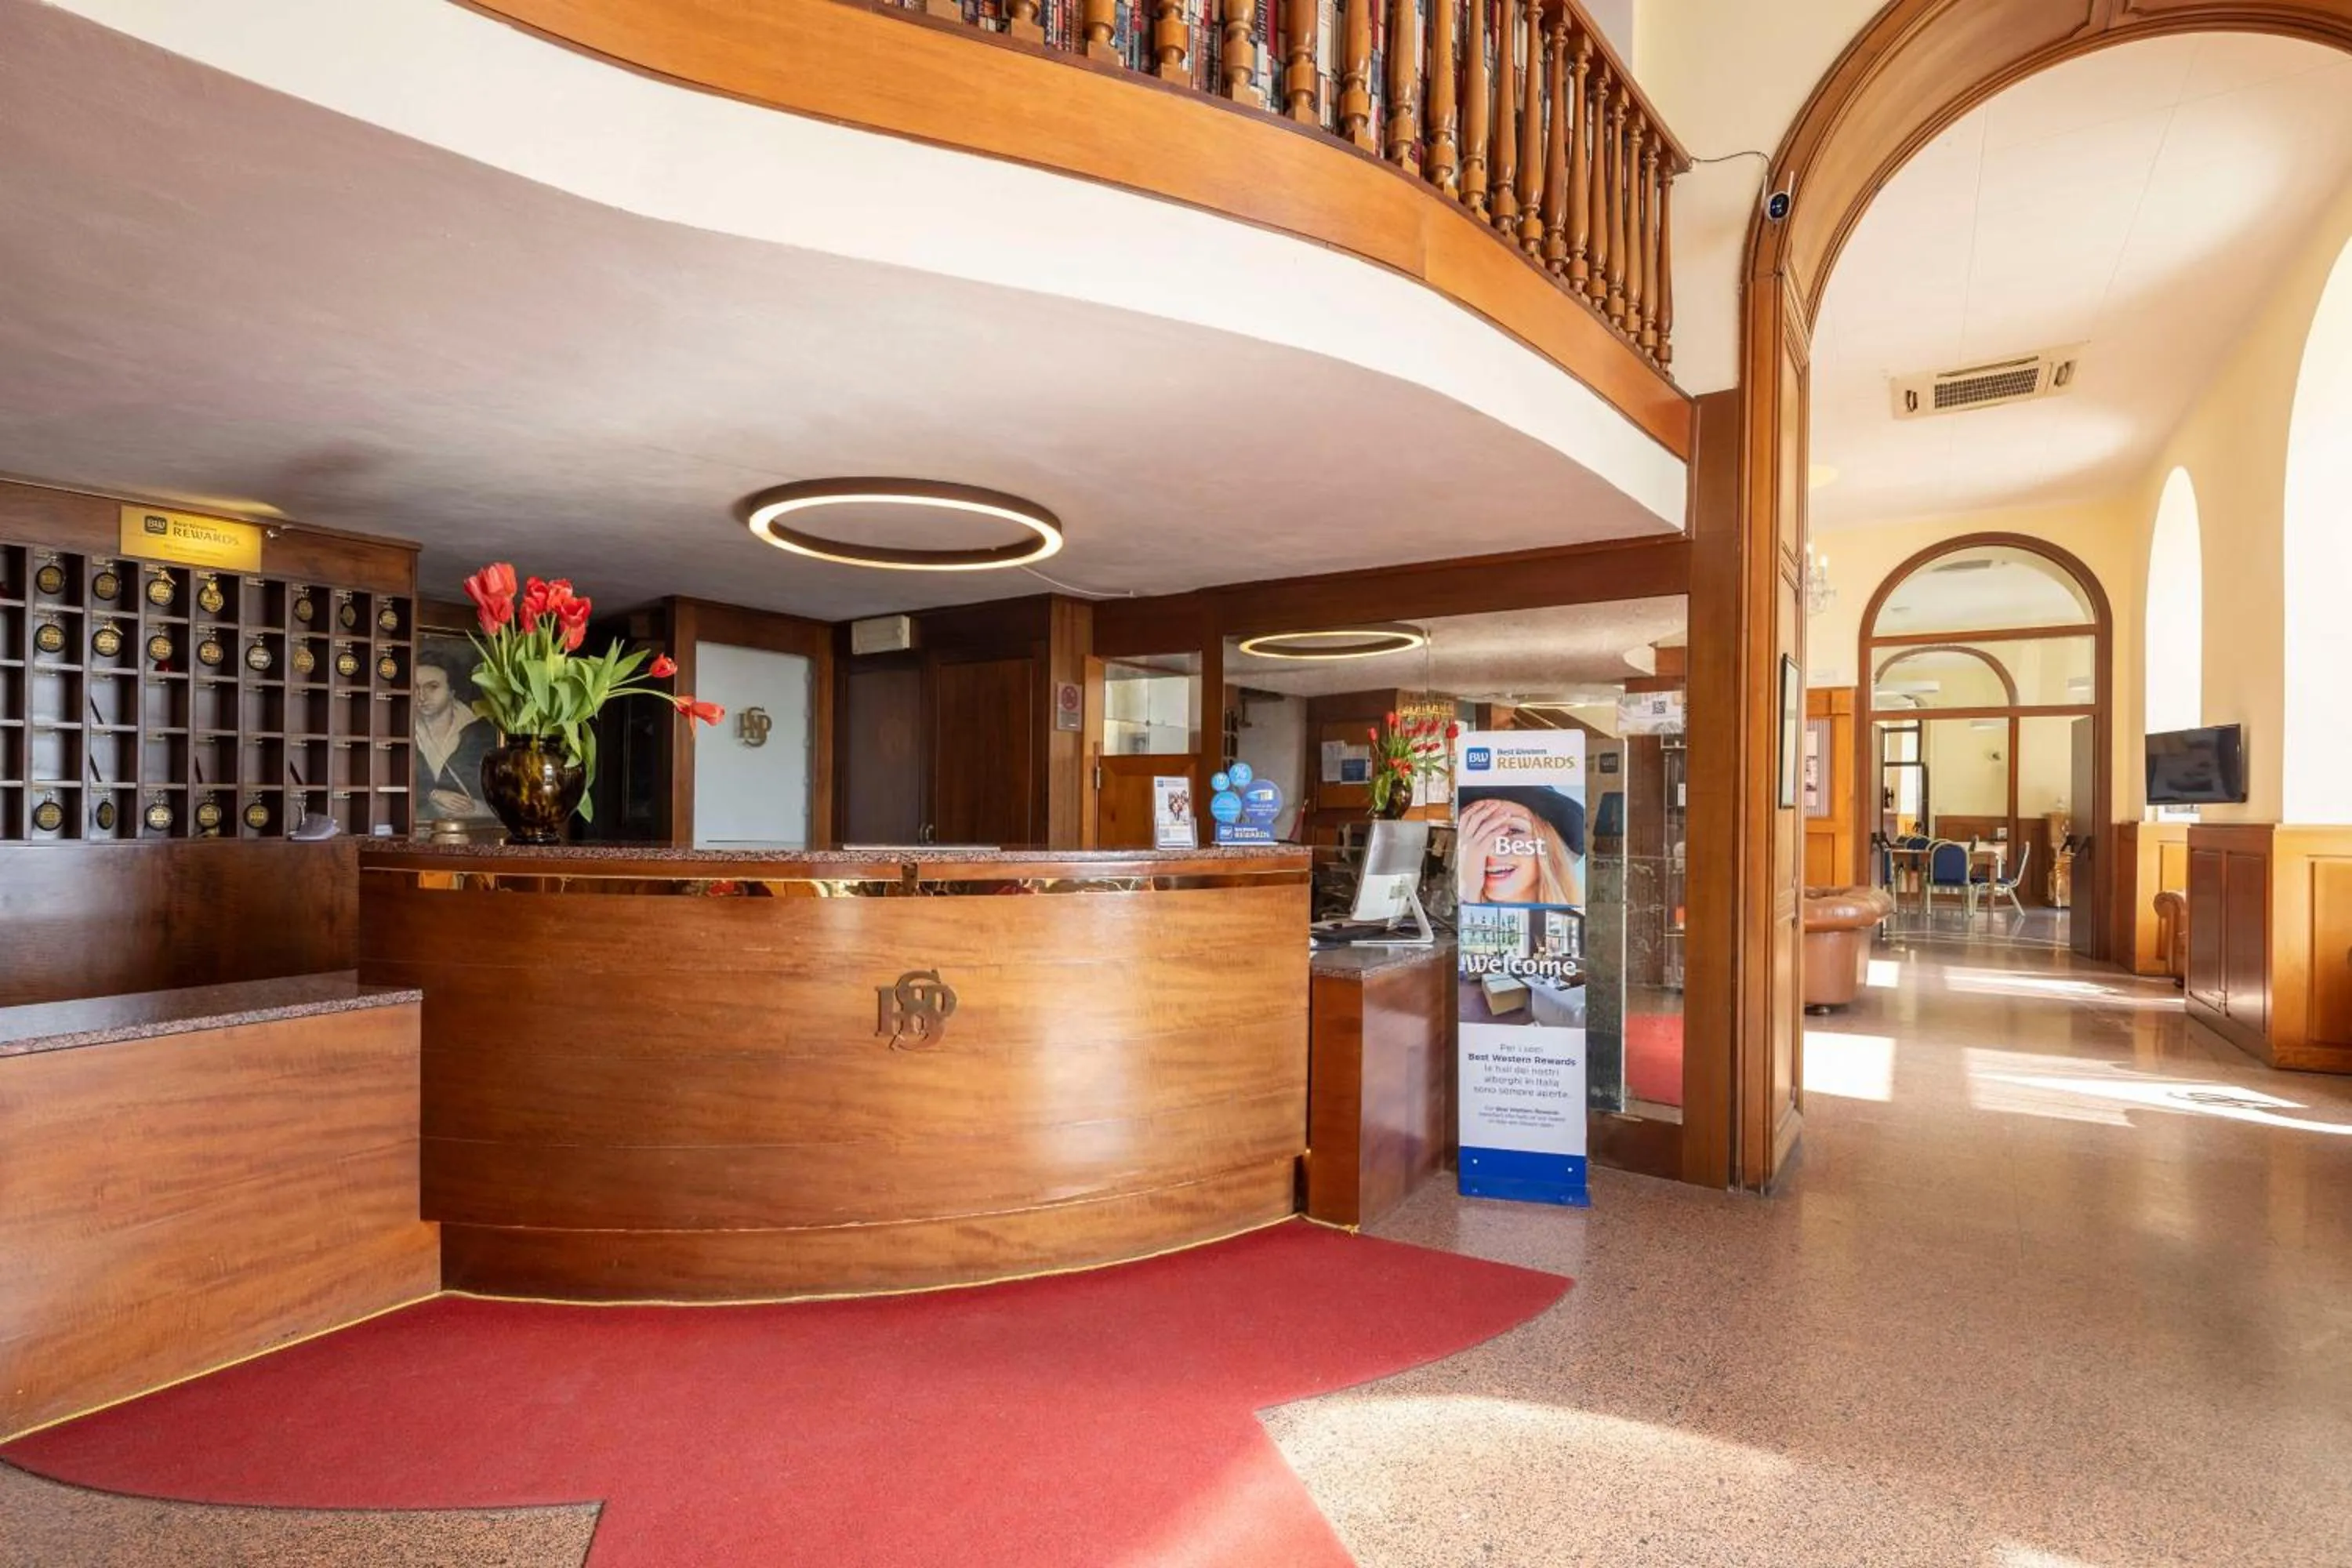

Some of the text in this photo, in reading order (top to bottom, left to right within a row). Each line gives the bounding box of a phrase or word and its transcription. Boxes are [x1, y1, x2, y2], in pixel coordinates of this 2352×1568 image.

[1497, 757, 1576, 769] REWARDS
[1494, 837, 1546, 855] Best
[1465, 954, 1577, 976] Welcome
[1500, 1044, 1515, 1052] Per
[1492, 1054, 1531, 1063] Western
[1534, 1056, 1577, 1066] Rewards
[1532, 1067, 1559, 1076] nostri
[1536, 1078, 1559, 1087] Italia
[1498, 1087, 1534, 1097] sempre
